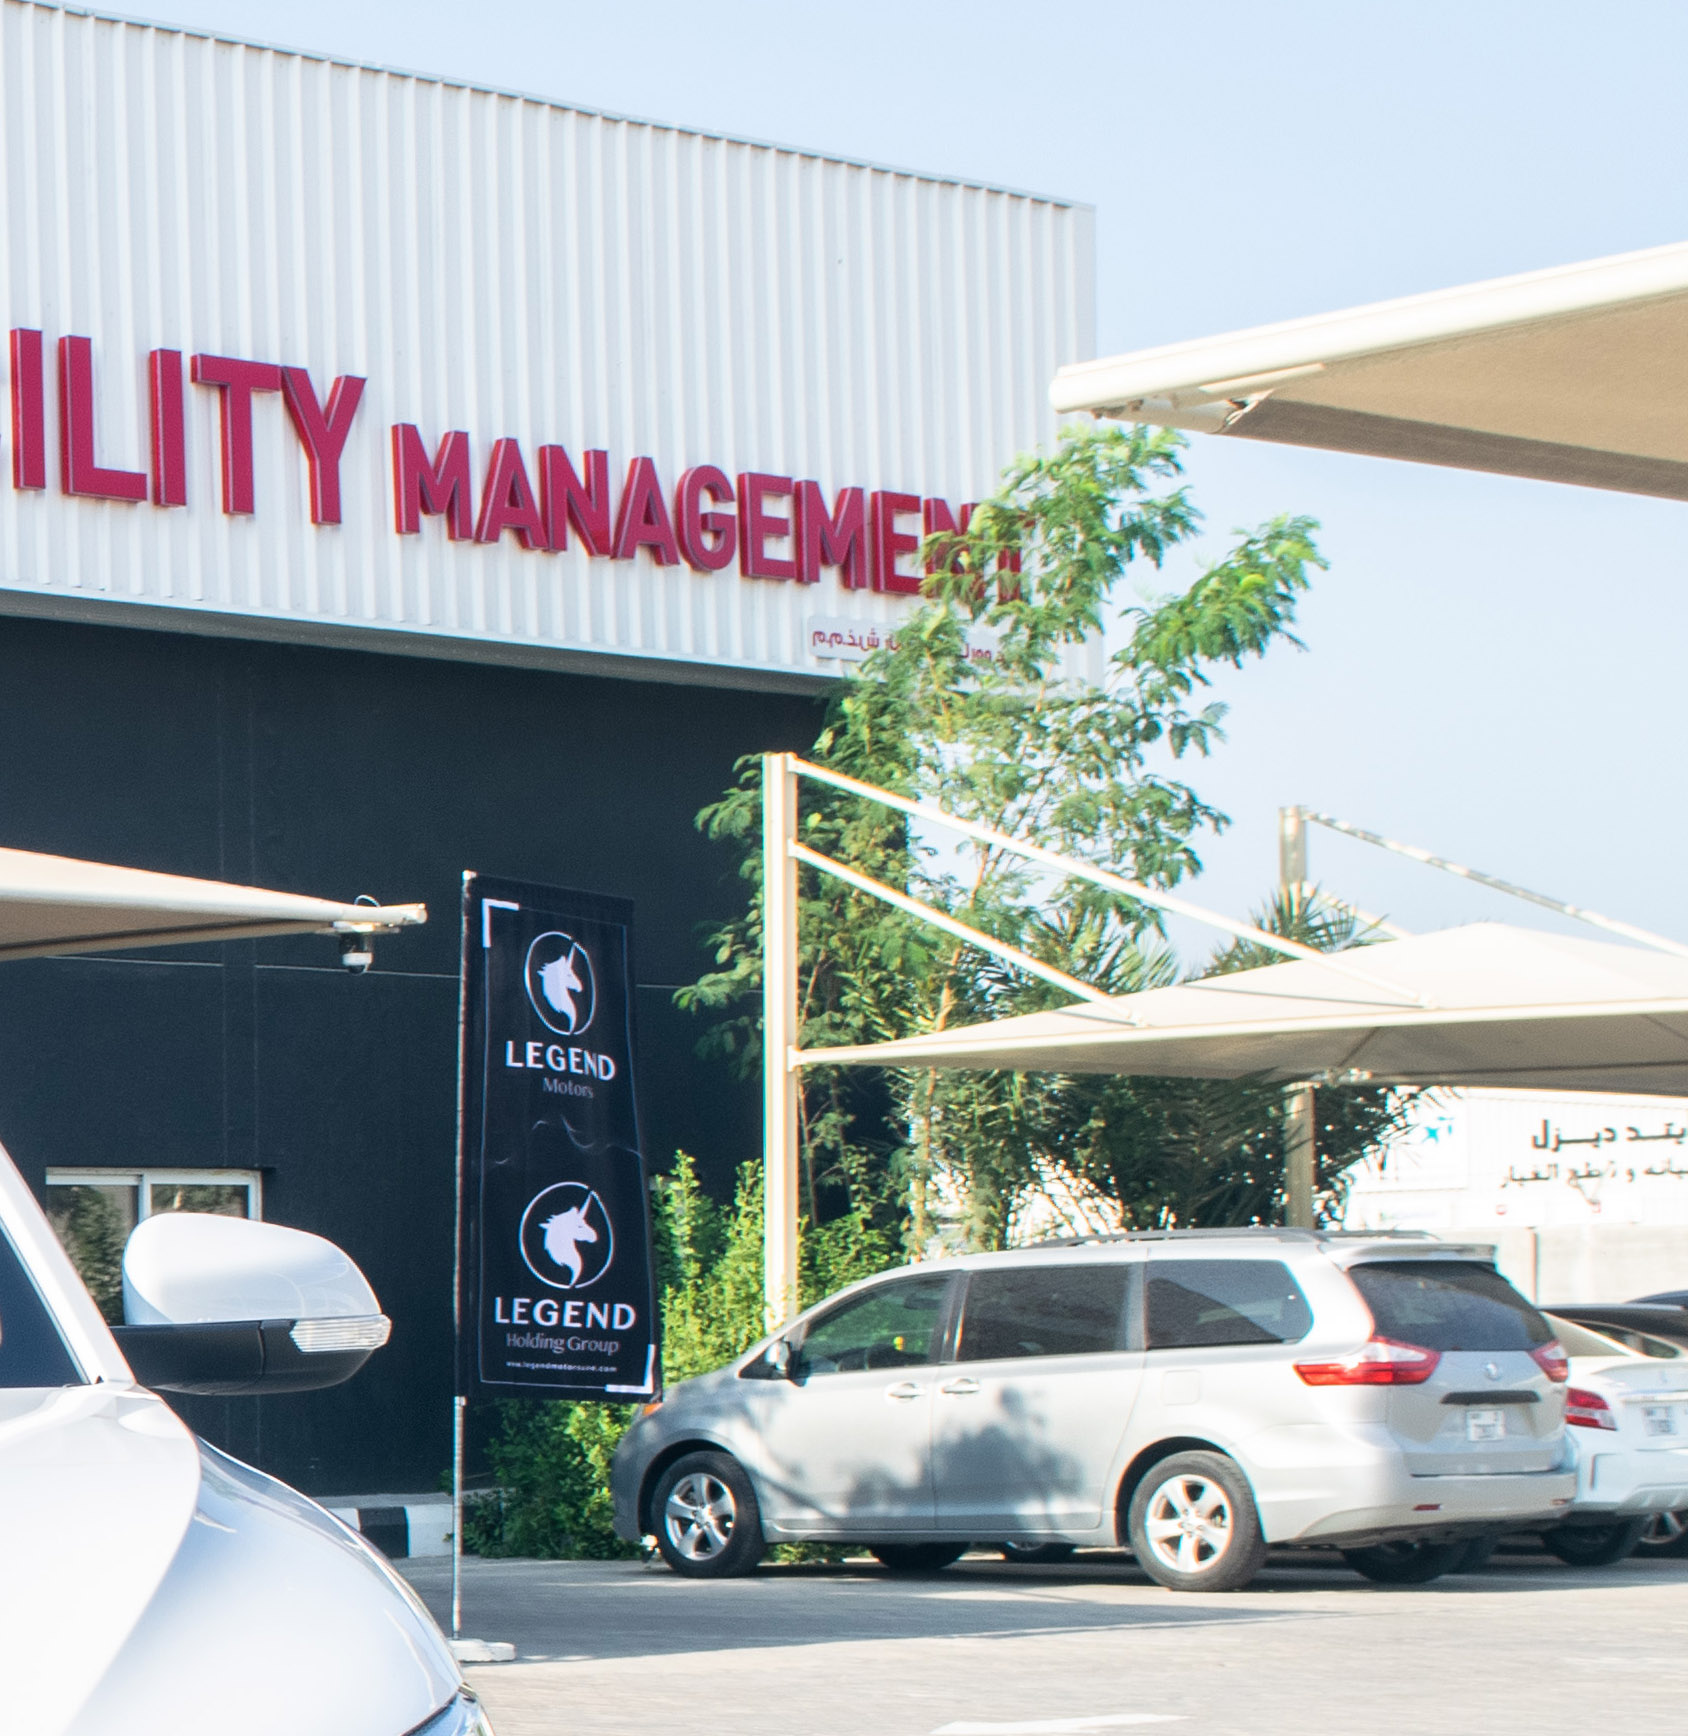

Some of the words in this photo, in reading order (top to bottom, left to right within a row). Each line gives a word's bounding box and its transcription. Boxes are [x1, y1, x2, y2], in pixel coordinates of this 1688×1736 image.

[505, 1040, 616, 1081] LEGEND
[542, 1076, 594, 1099] Motors
[495, 1296, 636, 1330] LEGEND
[505, 1332, 565, 1354] Holding
[566, 1335, 620, 1356] Group
